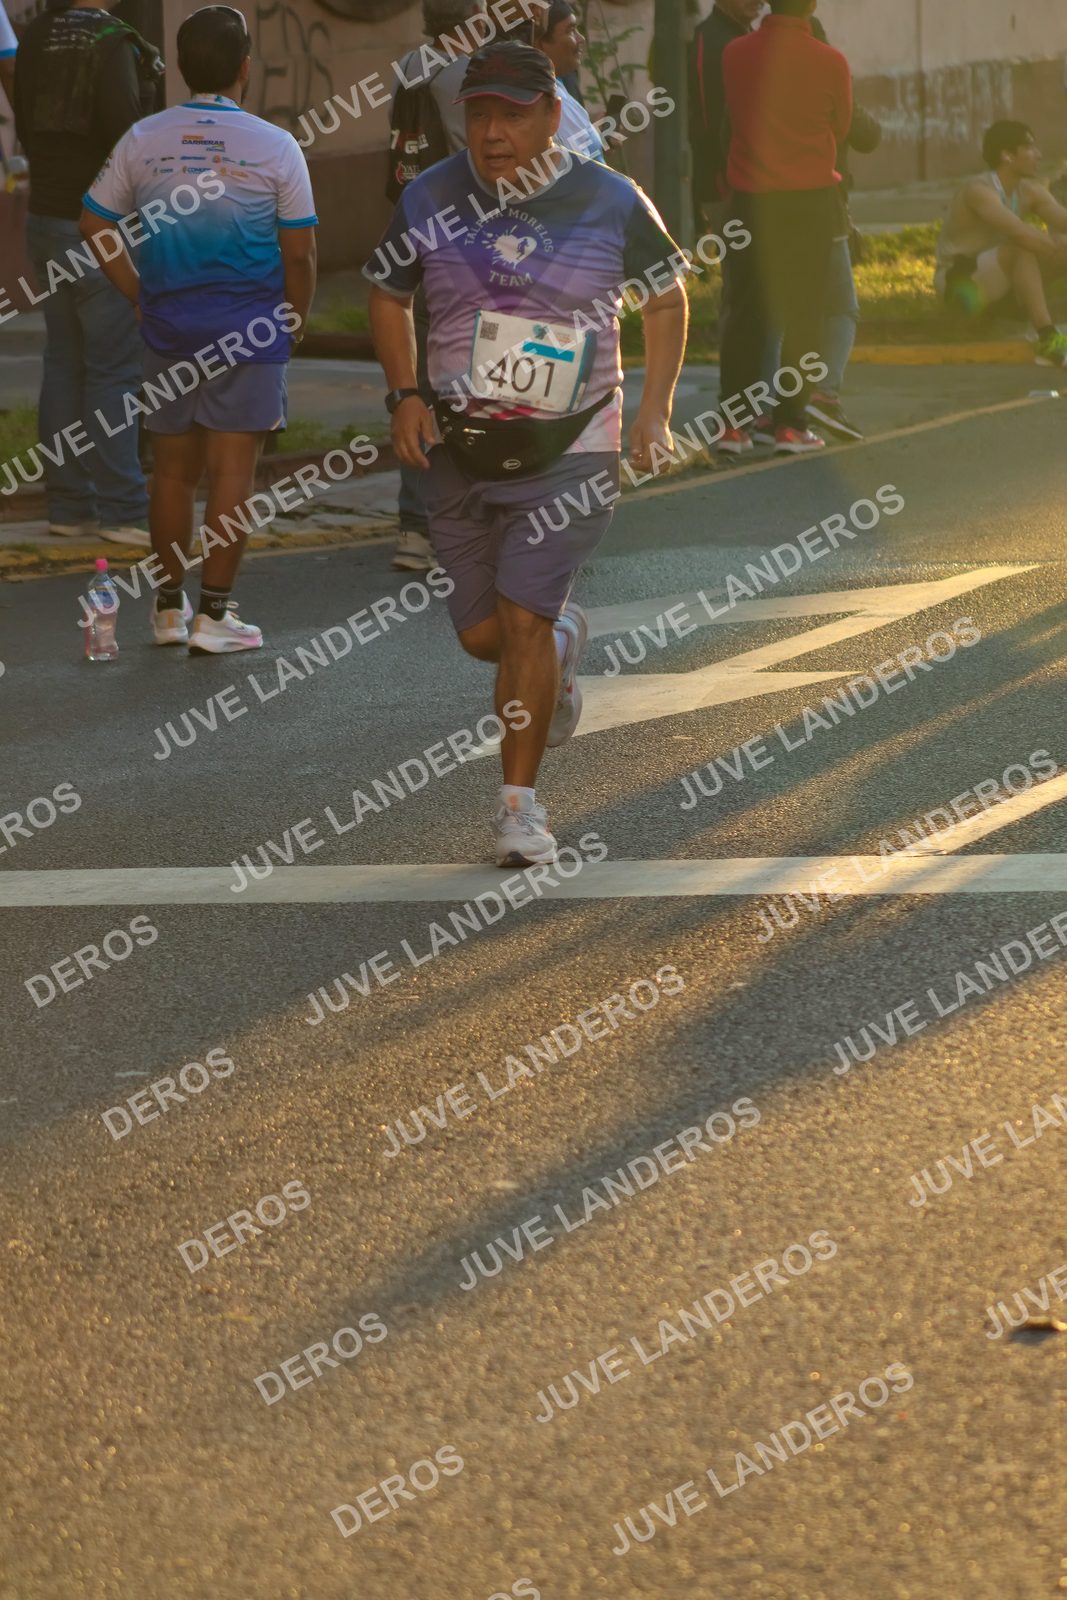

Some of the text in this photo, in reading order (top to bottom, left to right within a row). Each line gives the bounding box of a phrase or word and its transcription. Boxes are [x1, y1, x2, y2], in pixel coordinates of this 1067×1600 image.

[508, 203, 554, 253] MORELOS
[488, 269, 533, 287] TEAM
[487, 354, 555, 398] 401
